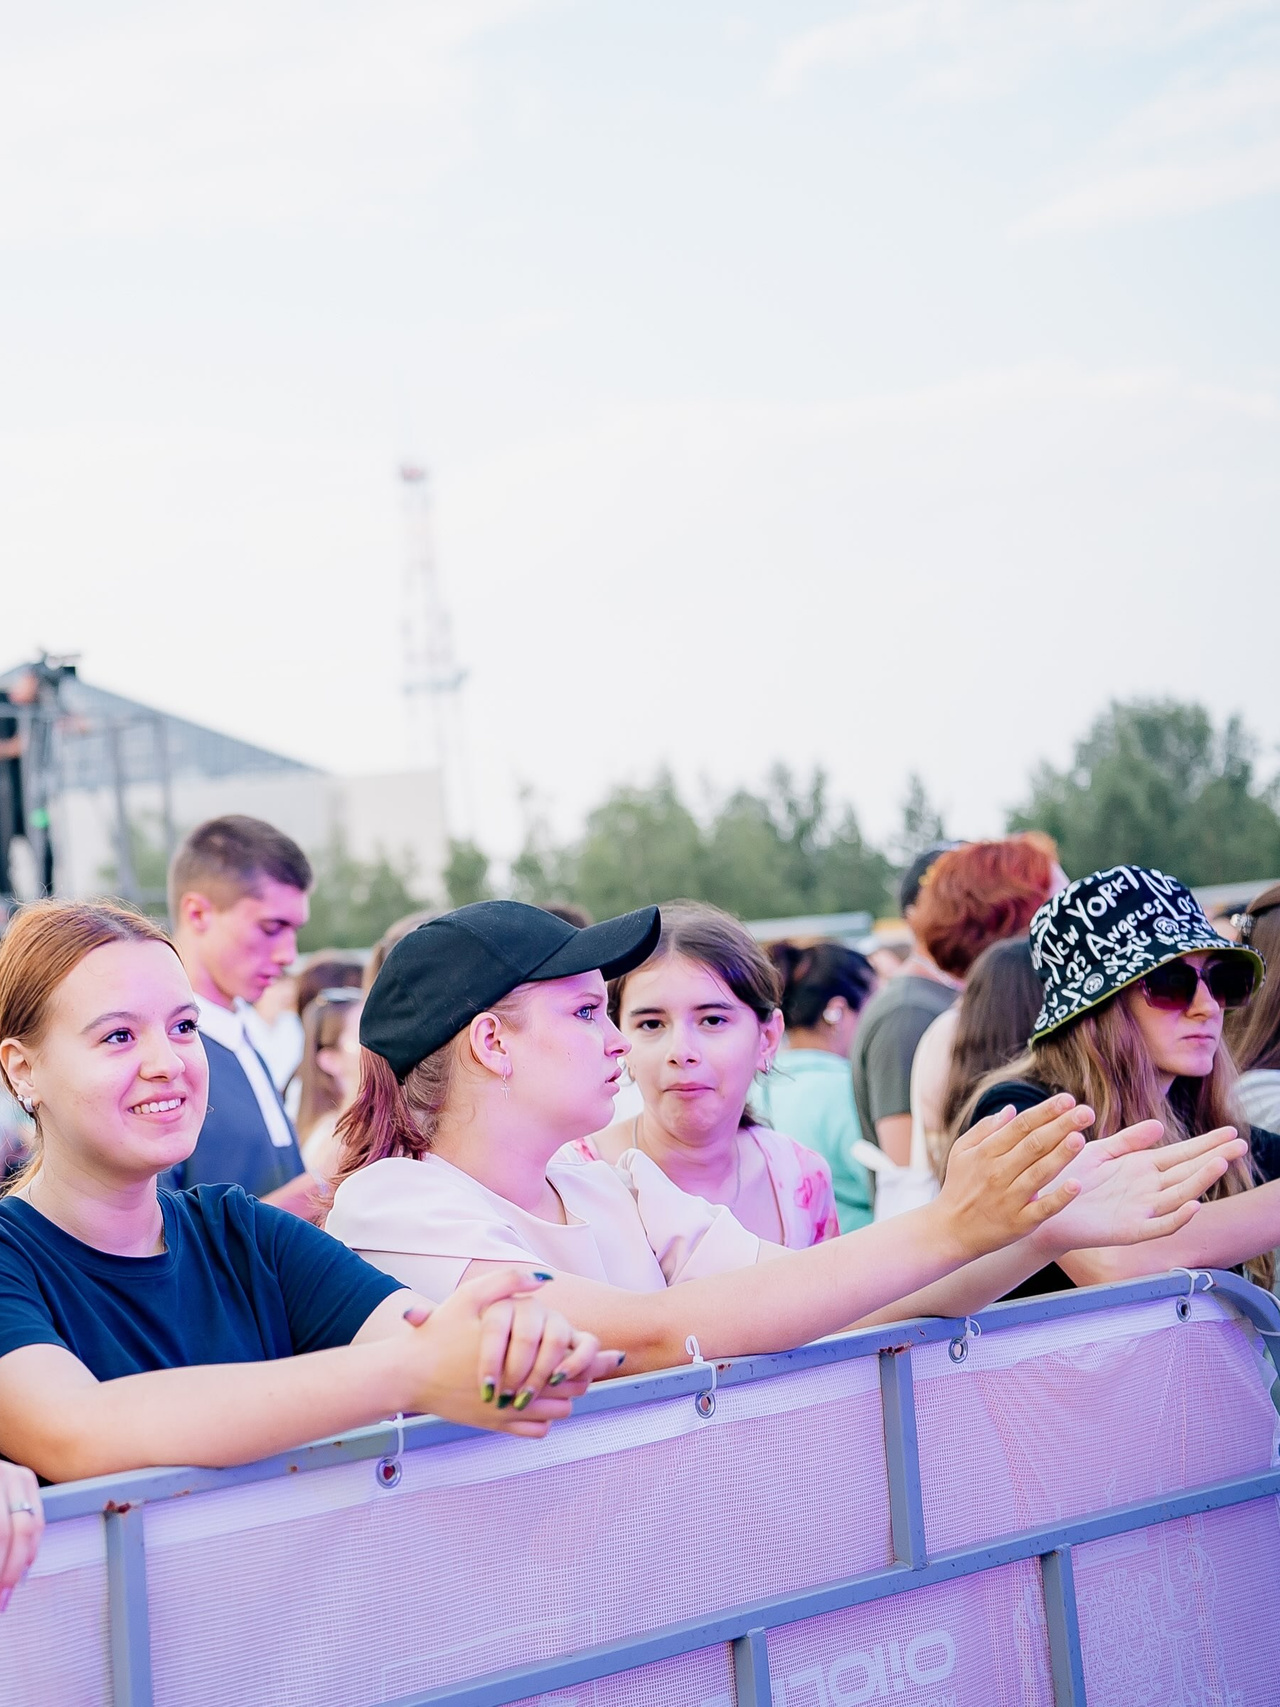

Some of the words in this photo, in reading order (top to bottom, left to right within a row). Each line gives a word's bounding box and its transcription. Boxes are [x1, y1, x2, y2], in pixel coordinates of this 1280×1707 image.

[1041, 924, 1080, 967] New
[1065, 875, 1130, 932] YORK
[1086, 898, 1164, 961] Angeles
